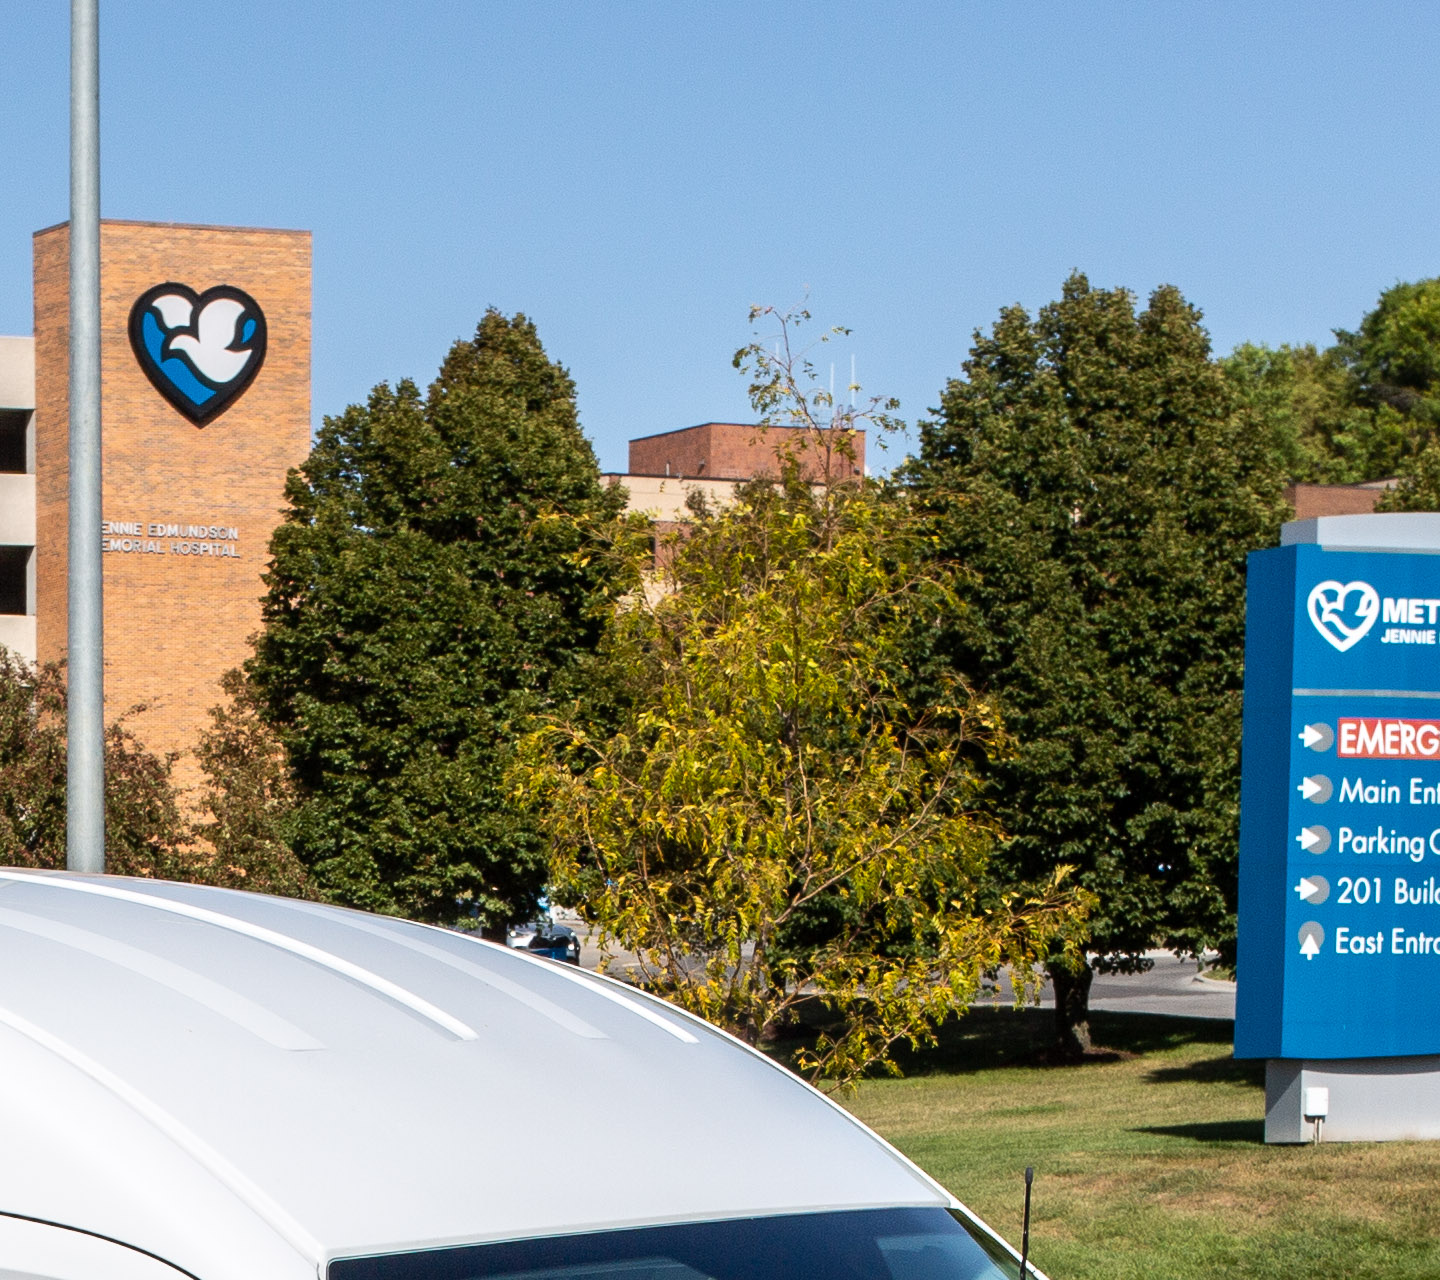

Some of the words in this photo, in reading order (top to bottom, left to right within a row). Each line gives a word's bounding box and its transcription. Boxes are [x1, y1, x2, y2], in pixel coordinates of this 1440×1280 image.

[102, 521, 143, 537] ENNIE
[148, 523, 239, 540] EDMUNDSON
[102, 538, 165, 555] EMORIAL
[170, 541, 241, 558] HOSPITAL
[1381, 628, 1436, 645] JENNIE
[1338, 777, 1401, 804] Main
[1338, 826, 1425, 863] Parking
[1337, 877, 1382, 904] 201
[1336, 927, 1384, 955] East
